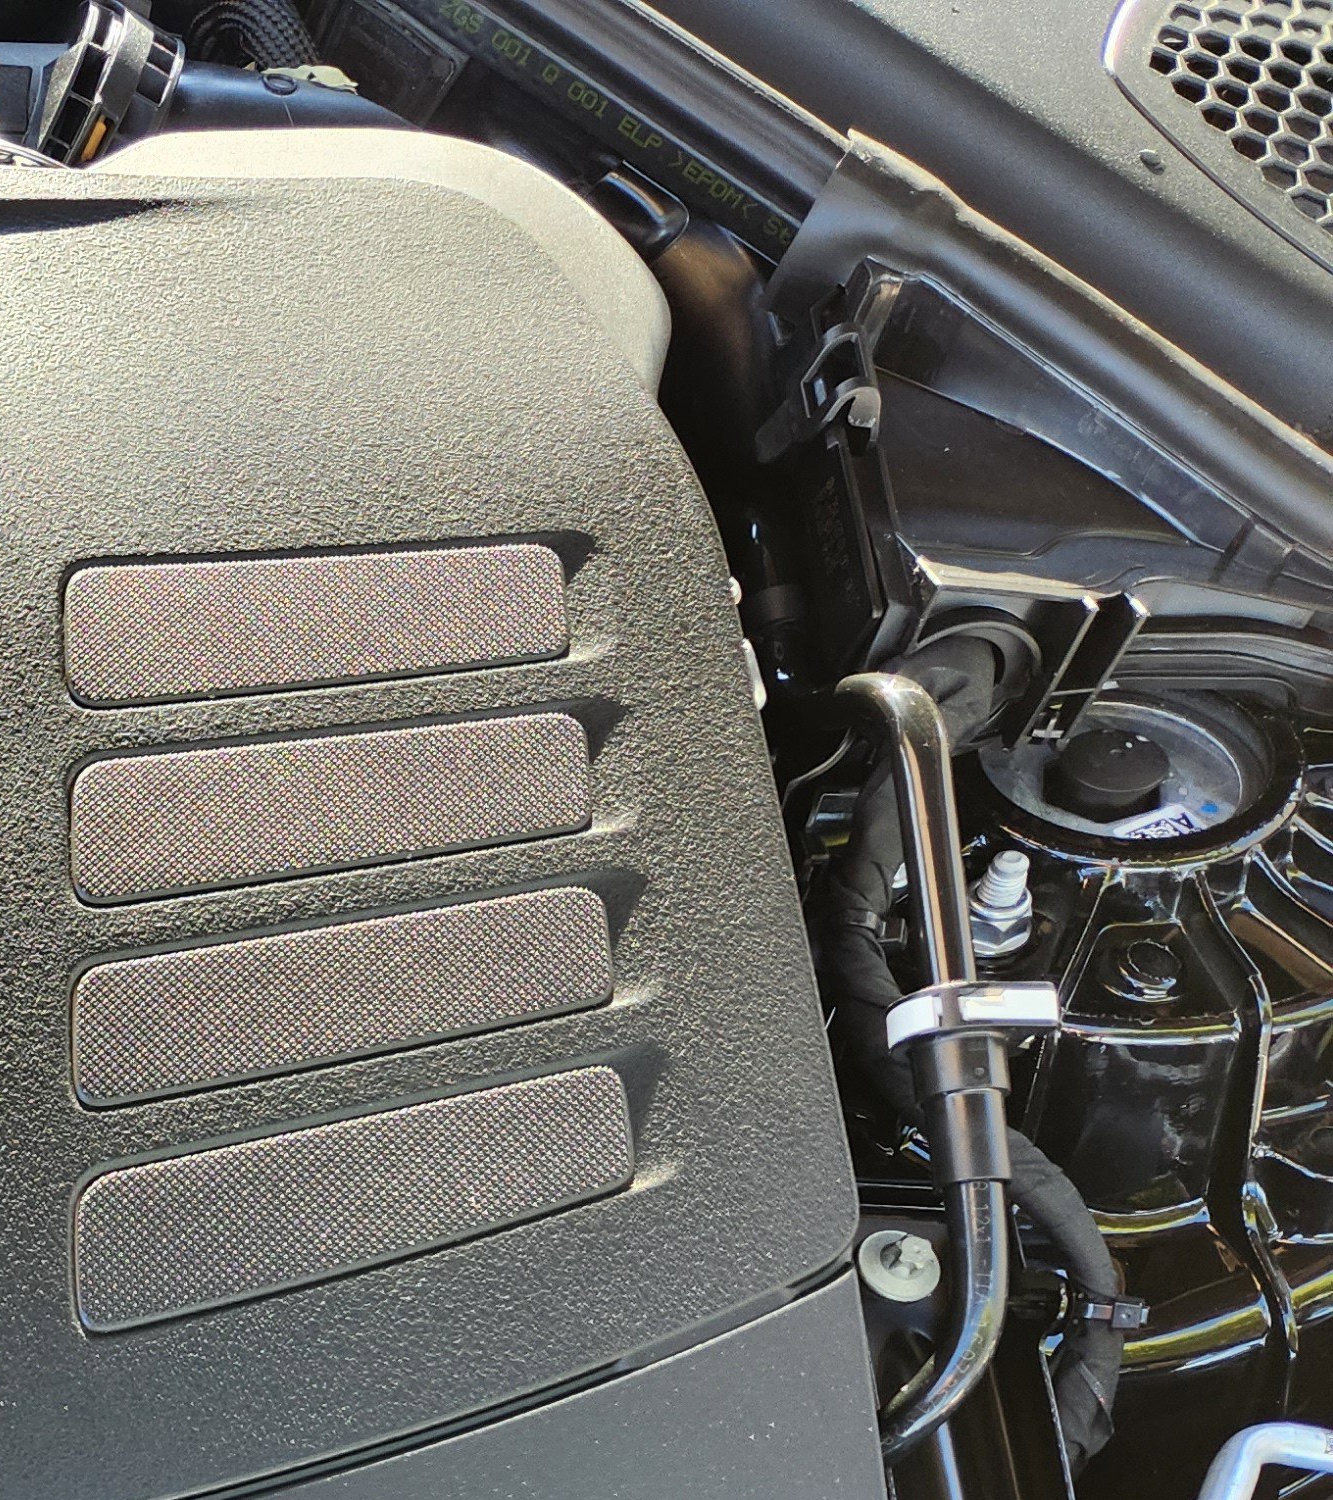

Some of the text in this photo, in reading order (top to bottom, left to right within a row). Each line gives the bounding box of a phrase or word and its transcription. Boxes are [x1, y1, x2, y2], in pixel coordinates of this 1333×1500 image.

[491, 28, 532, 67] 001
[567, 80, 609, 119] 001
[617, 114, 664, 148] ELP
